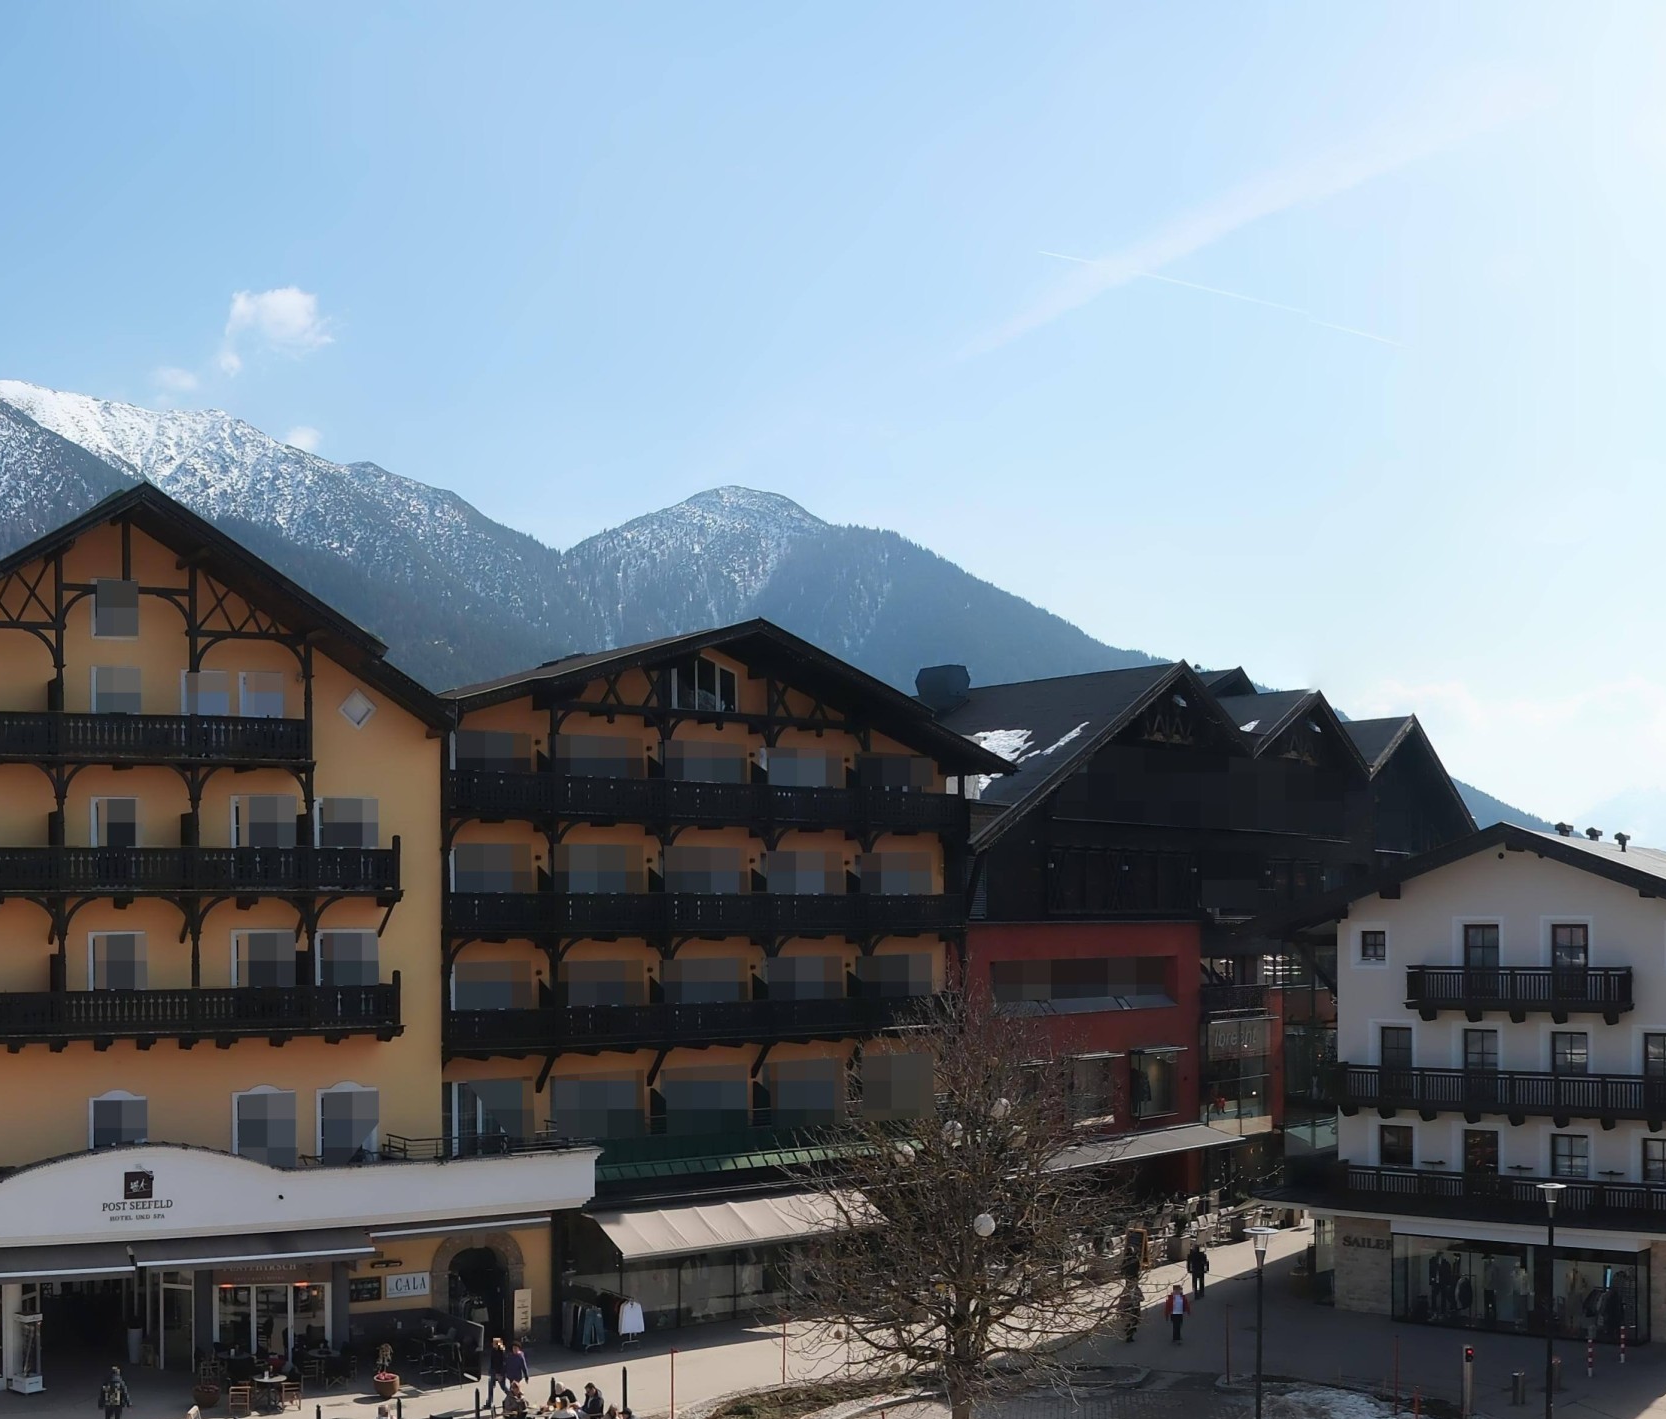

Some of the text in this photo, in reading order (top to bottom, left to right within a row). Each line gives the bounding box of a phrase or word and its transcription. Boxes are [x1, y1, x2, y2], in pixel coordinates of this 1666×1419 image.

[102, 1199, 173, 1212] POST SEEFELD
[109, 1214, 133, 1222] HOTEL
[135, 1213, 150, 1221] UND
[395, 1276, 426, 1292] CALA
